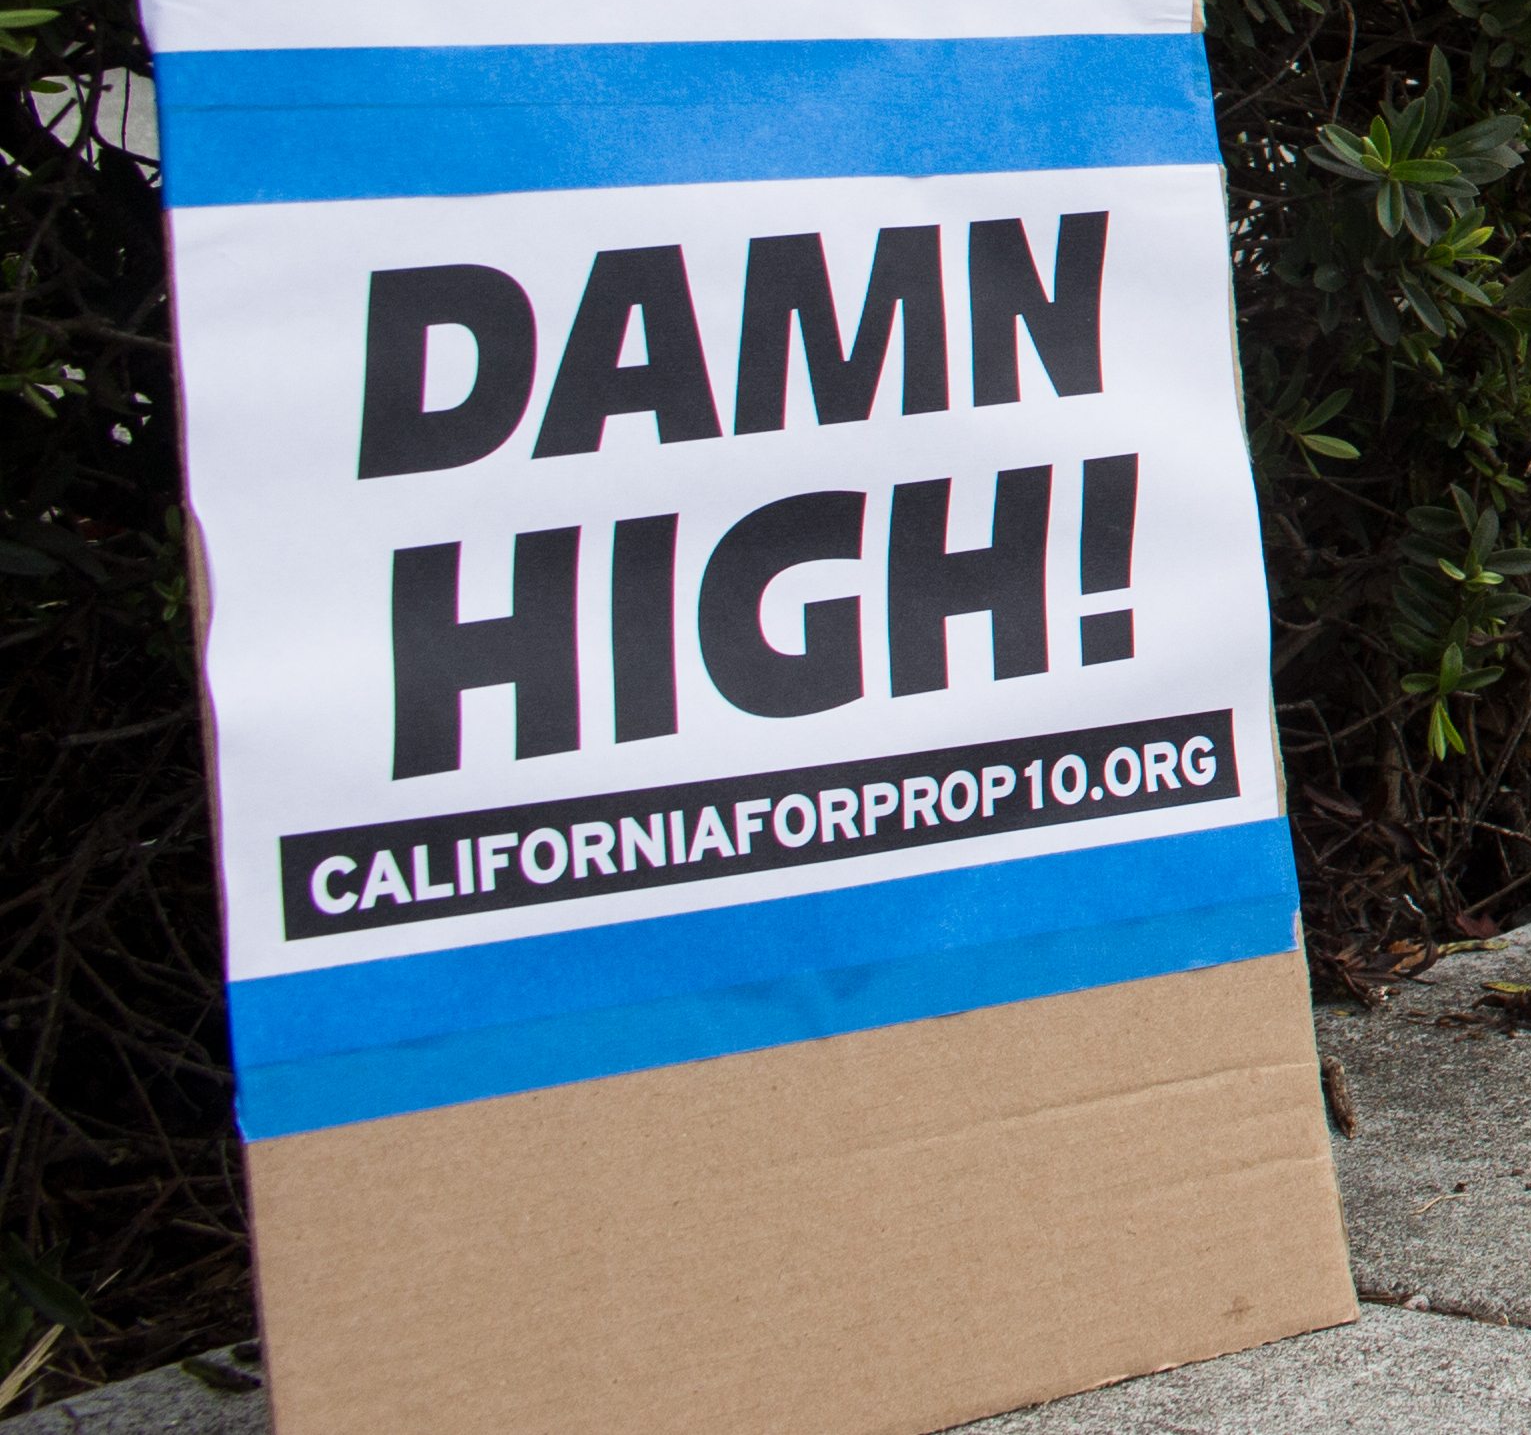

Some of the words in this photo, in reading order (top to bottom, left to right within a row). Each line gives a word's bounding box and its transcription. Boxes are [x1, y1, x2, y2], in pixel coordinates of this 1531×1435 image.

[356, 210, 1110, 480] DAMN
[391, 453, 1139, 781] HIGH!
[310, 735, 1217, 915] CALIFORNIAFORPROP10.ORG
